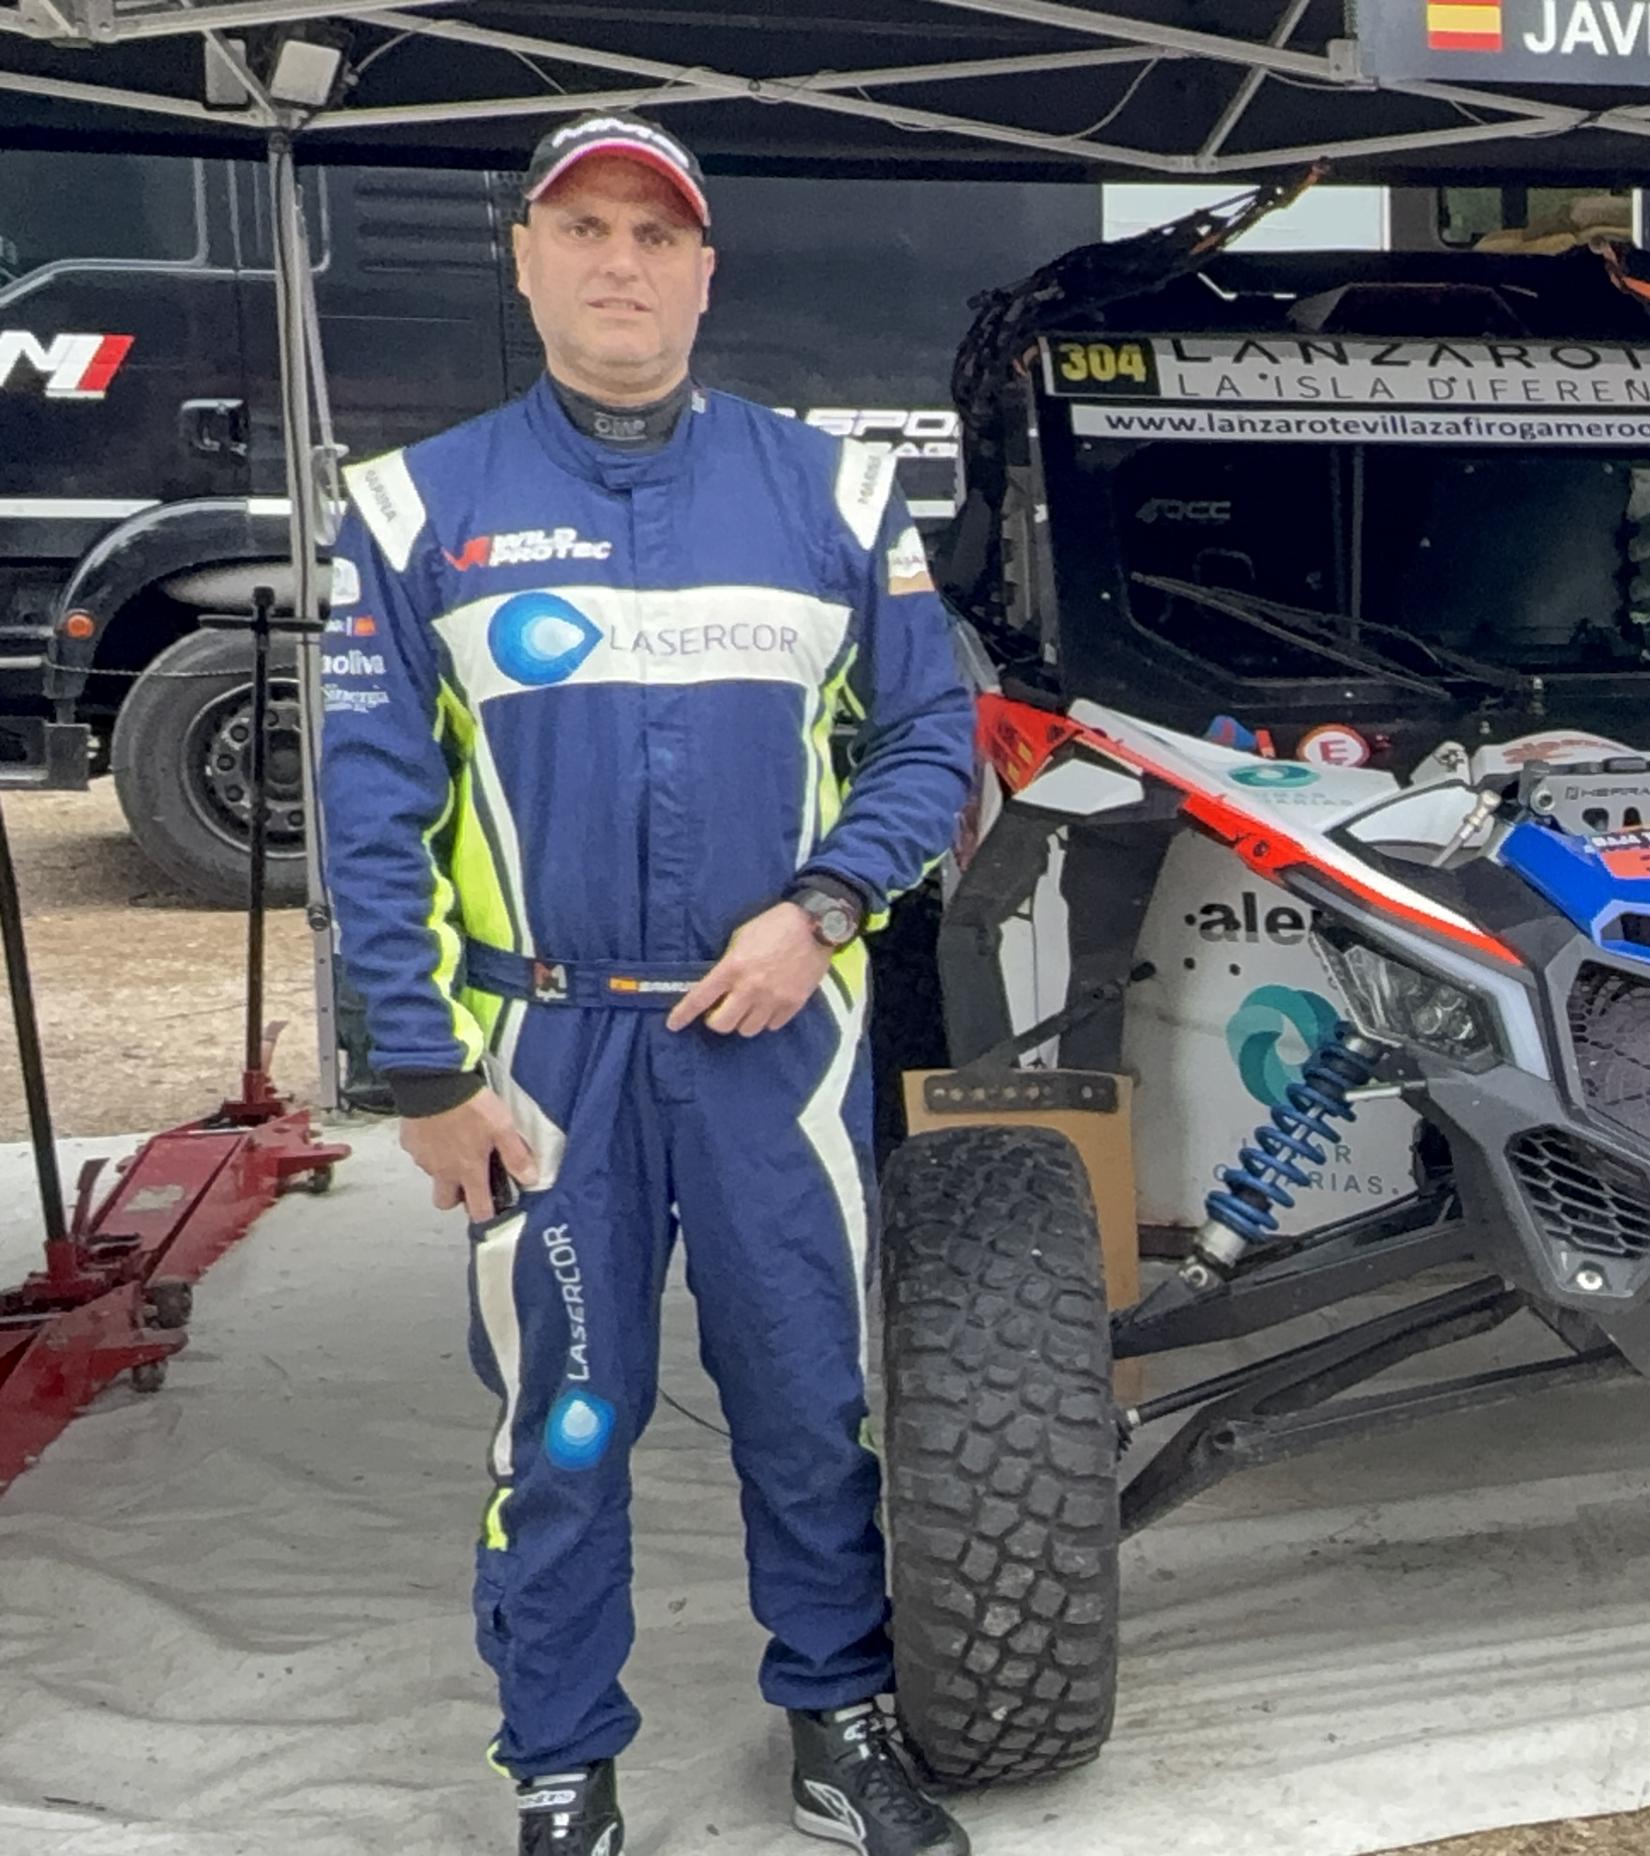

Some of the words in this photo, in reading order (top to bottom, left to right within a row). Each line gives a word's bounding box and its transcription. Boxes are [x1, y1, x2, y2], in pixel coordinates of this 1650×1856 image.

[1060, 343, 1147, 382] 304
[1178, 373, 1243, 397] LA
[1274, 375, 1396, 399] ISLA
[805, 408, 962, 438] SPO
[609, 623, 799, 655] LASERCOR
[1320, 740, 1347, 763] E
[1199, 892, 1323, 945] ale
[542, 1223, 591, 1381] LASERCOR
